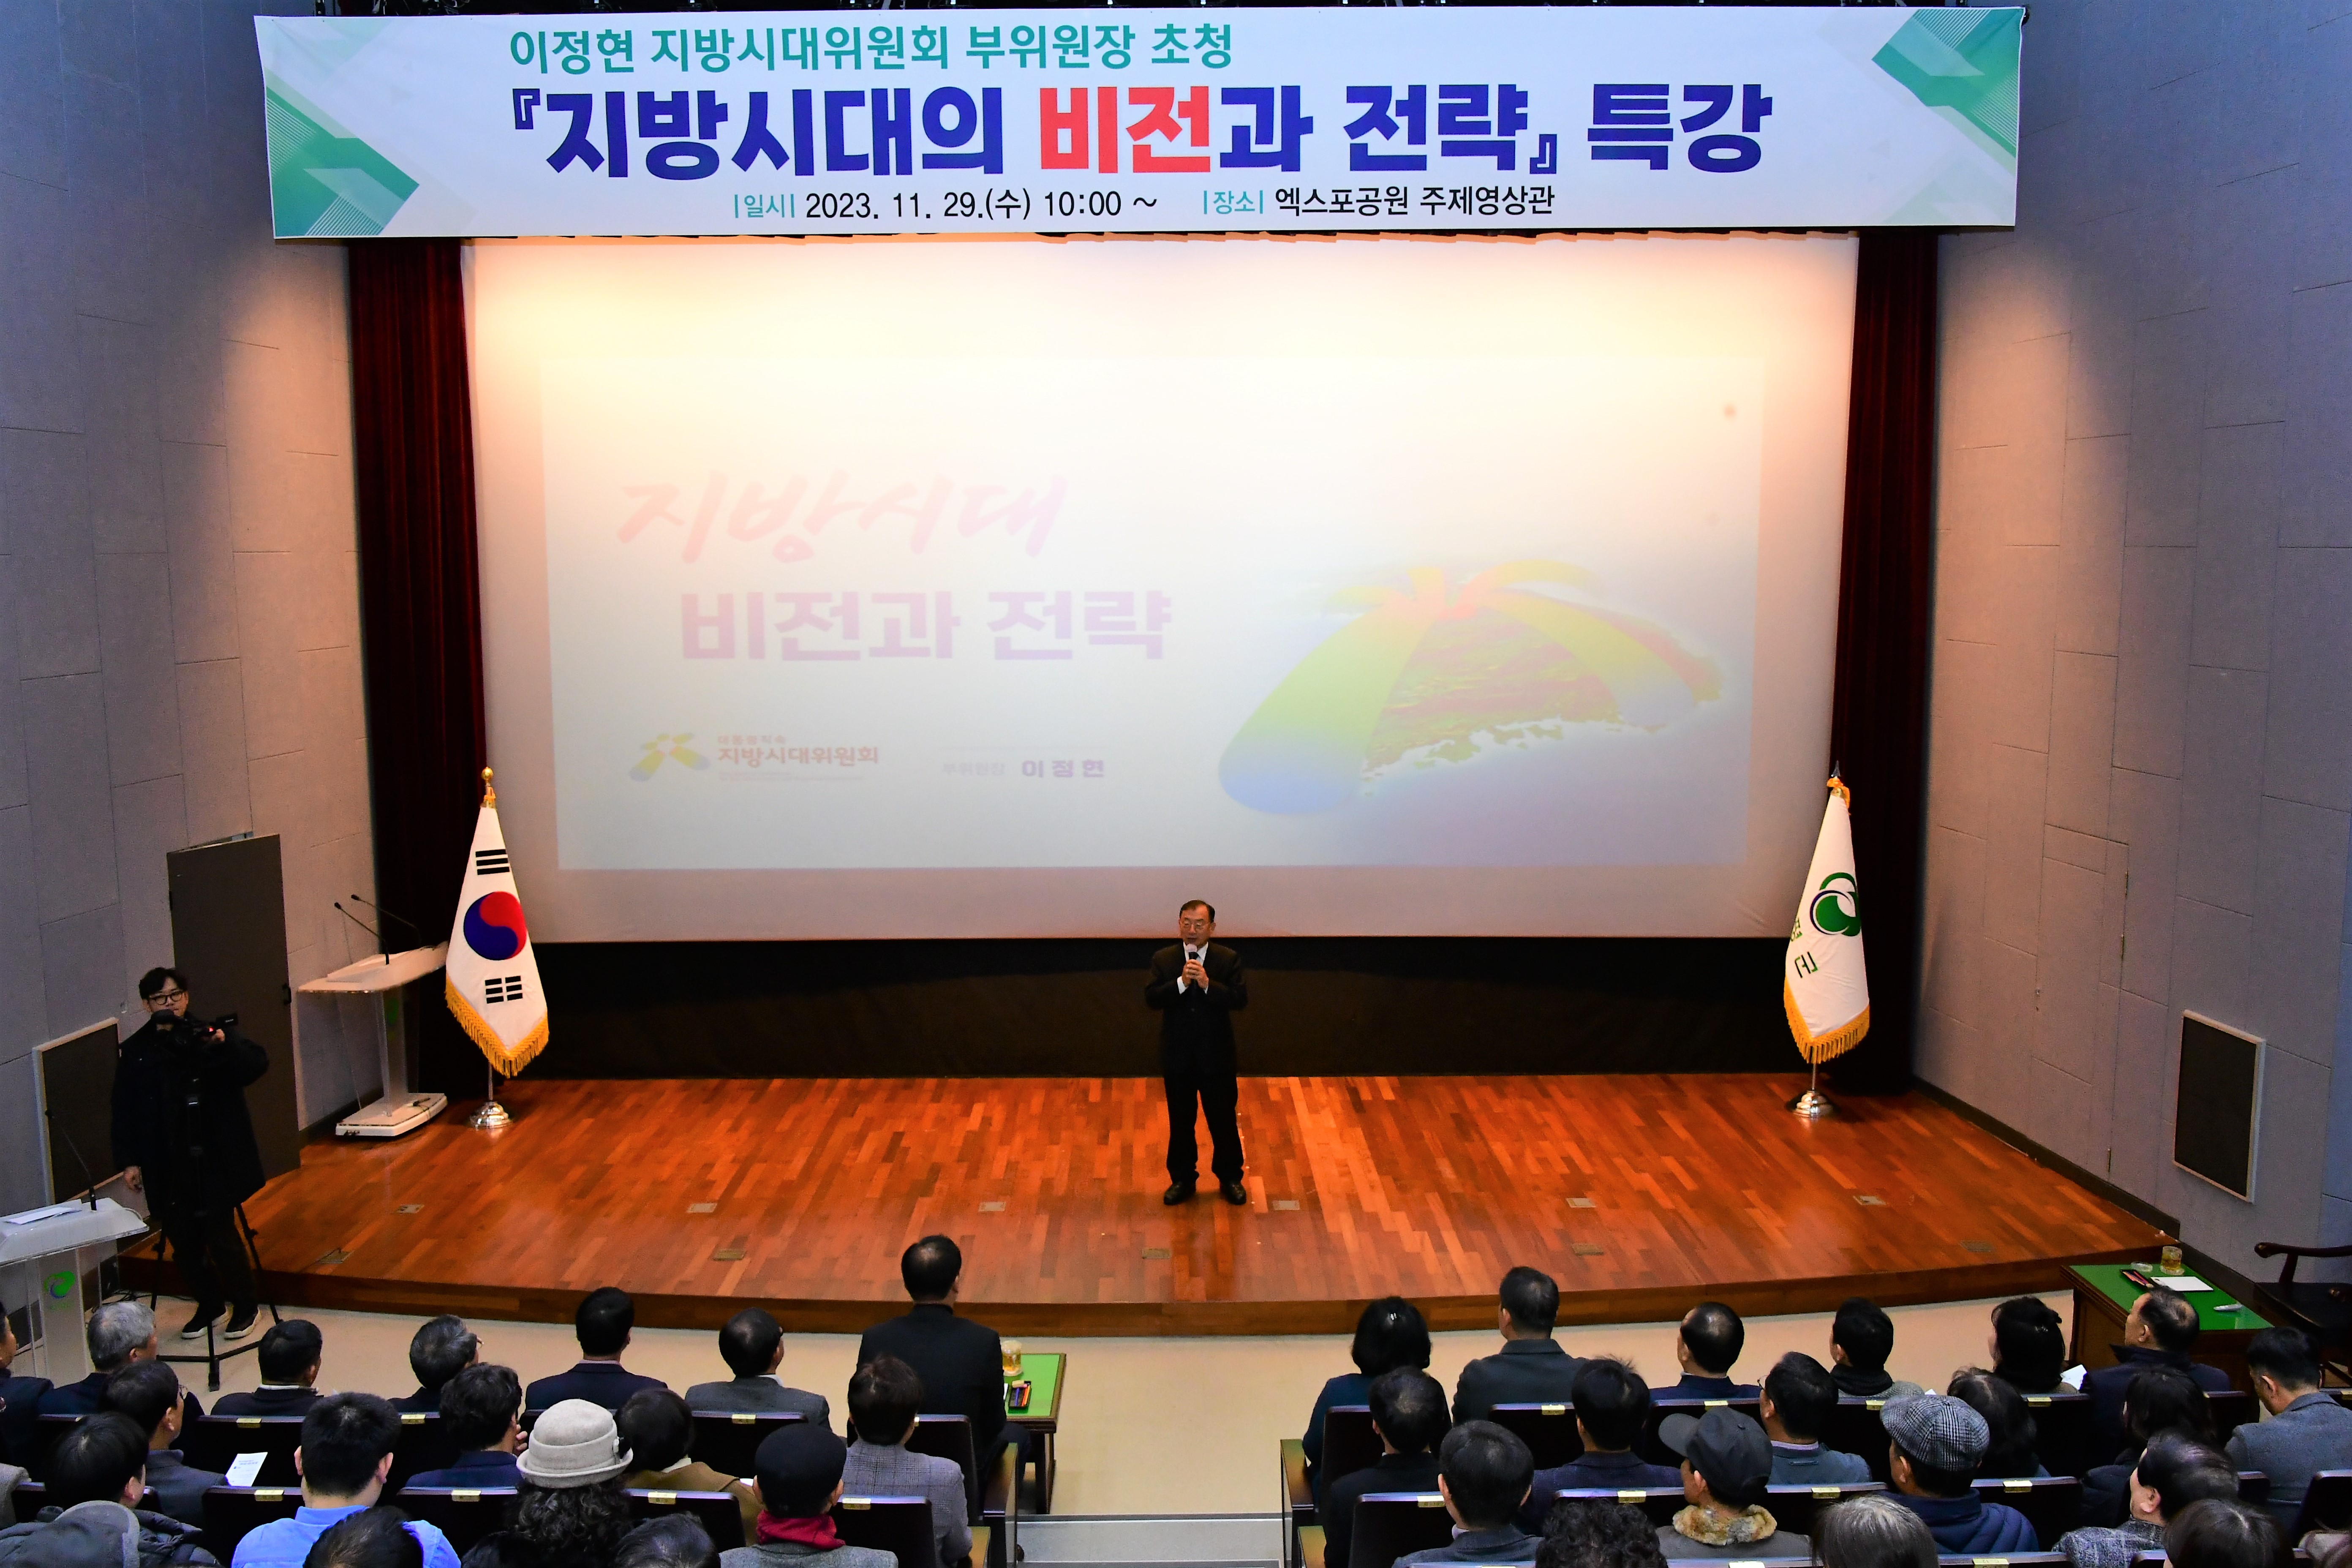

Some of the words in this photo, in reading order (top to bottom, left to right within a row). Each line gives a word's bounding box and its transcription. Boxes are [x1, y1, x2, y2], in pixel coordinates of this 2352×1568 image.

[510, 29, 634, 75] 이정현
[651, 25, 948, 73] 지방시대위원회
[966, 24, 1136, 69] 부위원장
[1151, 23, 1231, 69] 초청
[512, 86, 1003, 181] 『지방시대의
[1040, 85, 1314, 174] 비전과
[1343, 84, 1557, 174] 전략』
[1587, 84, 1773, 173] 특강
[806, 193, 879, 219] 2023.
[893, 193, 931, 219] 11.
[944, 188, 1030, 220] 29.(수)
[1045, 191, 1121, 216] 10:00
[1275, 186, 1408, 217] 엑스포공원
[1420, 185, 1555, 216] 주제영상관
[617, 469, 1069, 564] 지방시대
[681, 591, 961, 662] 비전과
[986, 590, 1172, 660] 전략
[718, 746, 879, 768] 지방시대위원회
